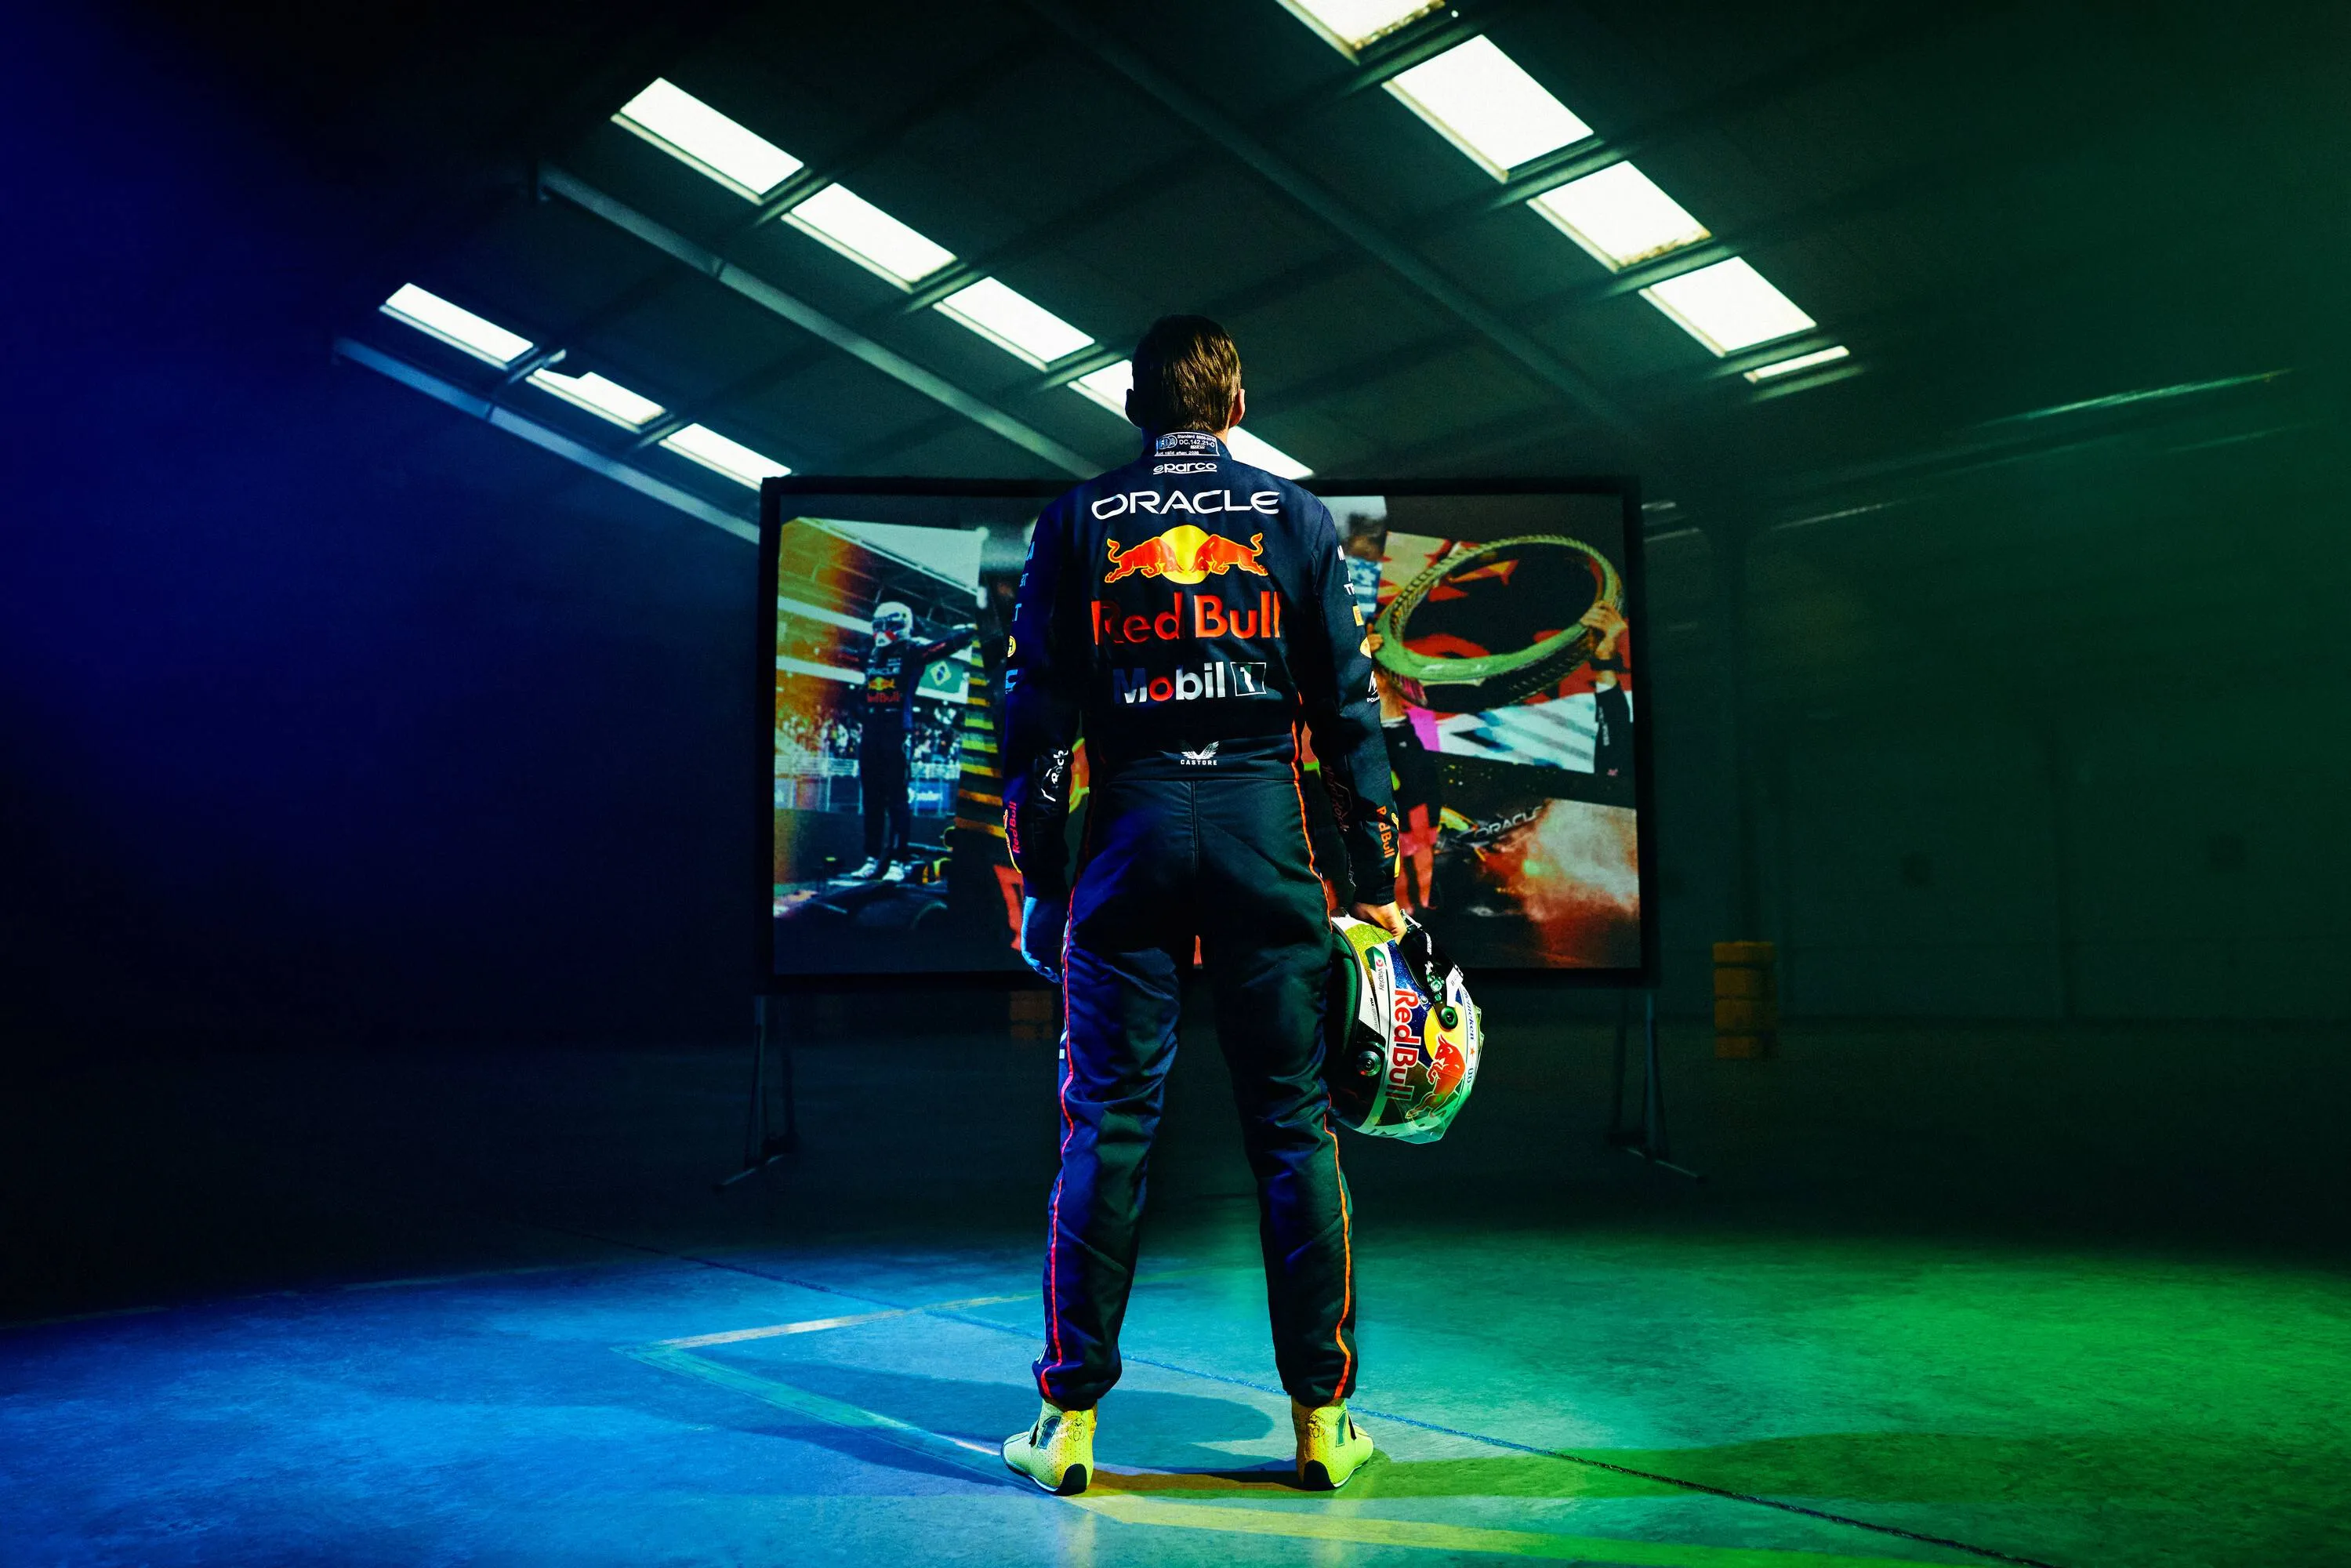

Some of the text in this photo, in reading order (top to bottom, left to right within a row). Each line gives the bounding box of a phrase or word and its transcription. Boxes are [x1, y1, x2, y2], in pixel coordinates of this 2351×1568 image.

[1153, 463, 1217, 474] sparco
[1091, 489, 1280, 520] ORACLE
[1090, 590, 1283, 646] Red Bull
[1112, 661, 1256, 704] Mobil 1
[1009, 800, 1018, 828] Bull
[1376, 805, 1395, 859] Rd Bull
[1384, 989, 1420, 1100] Red Bull
